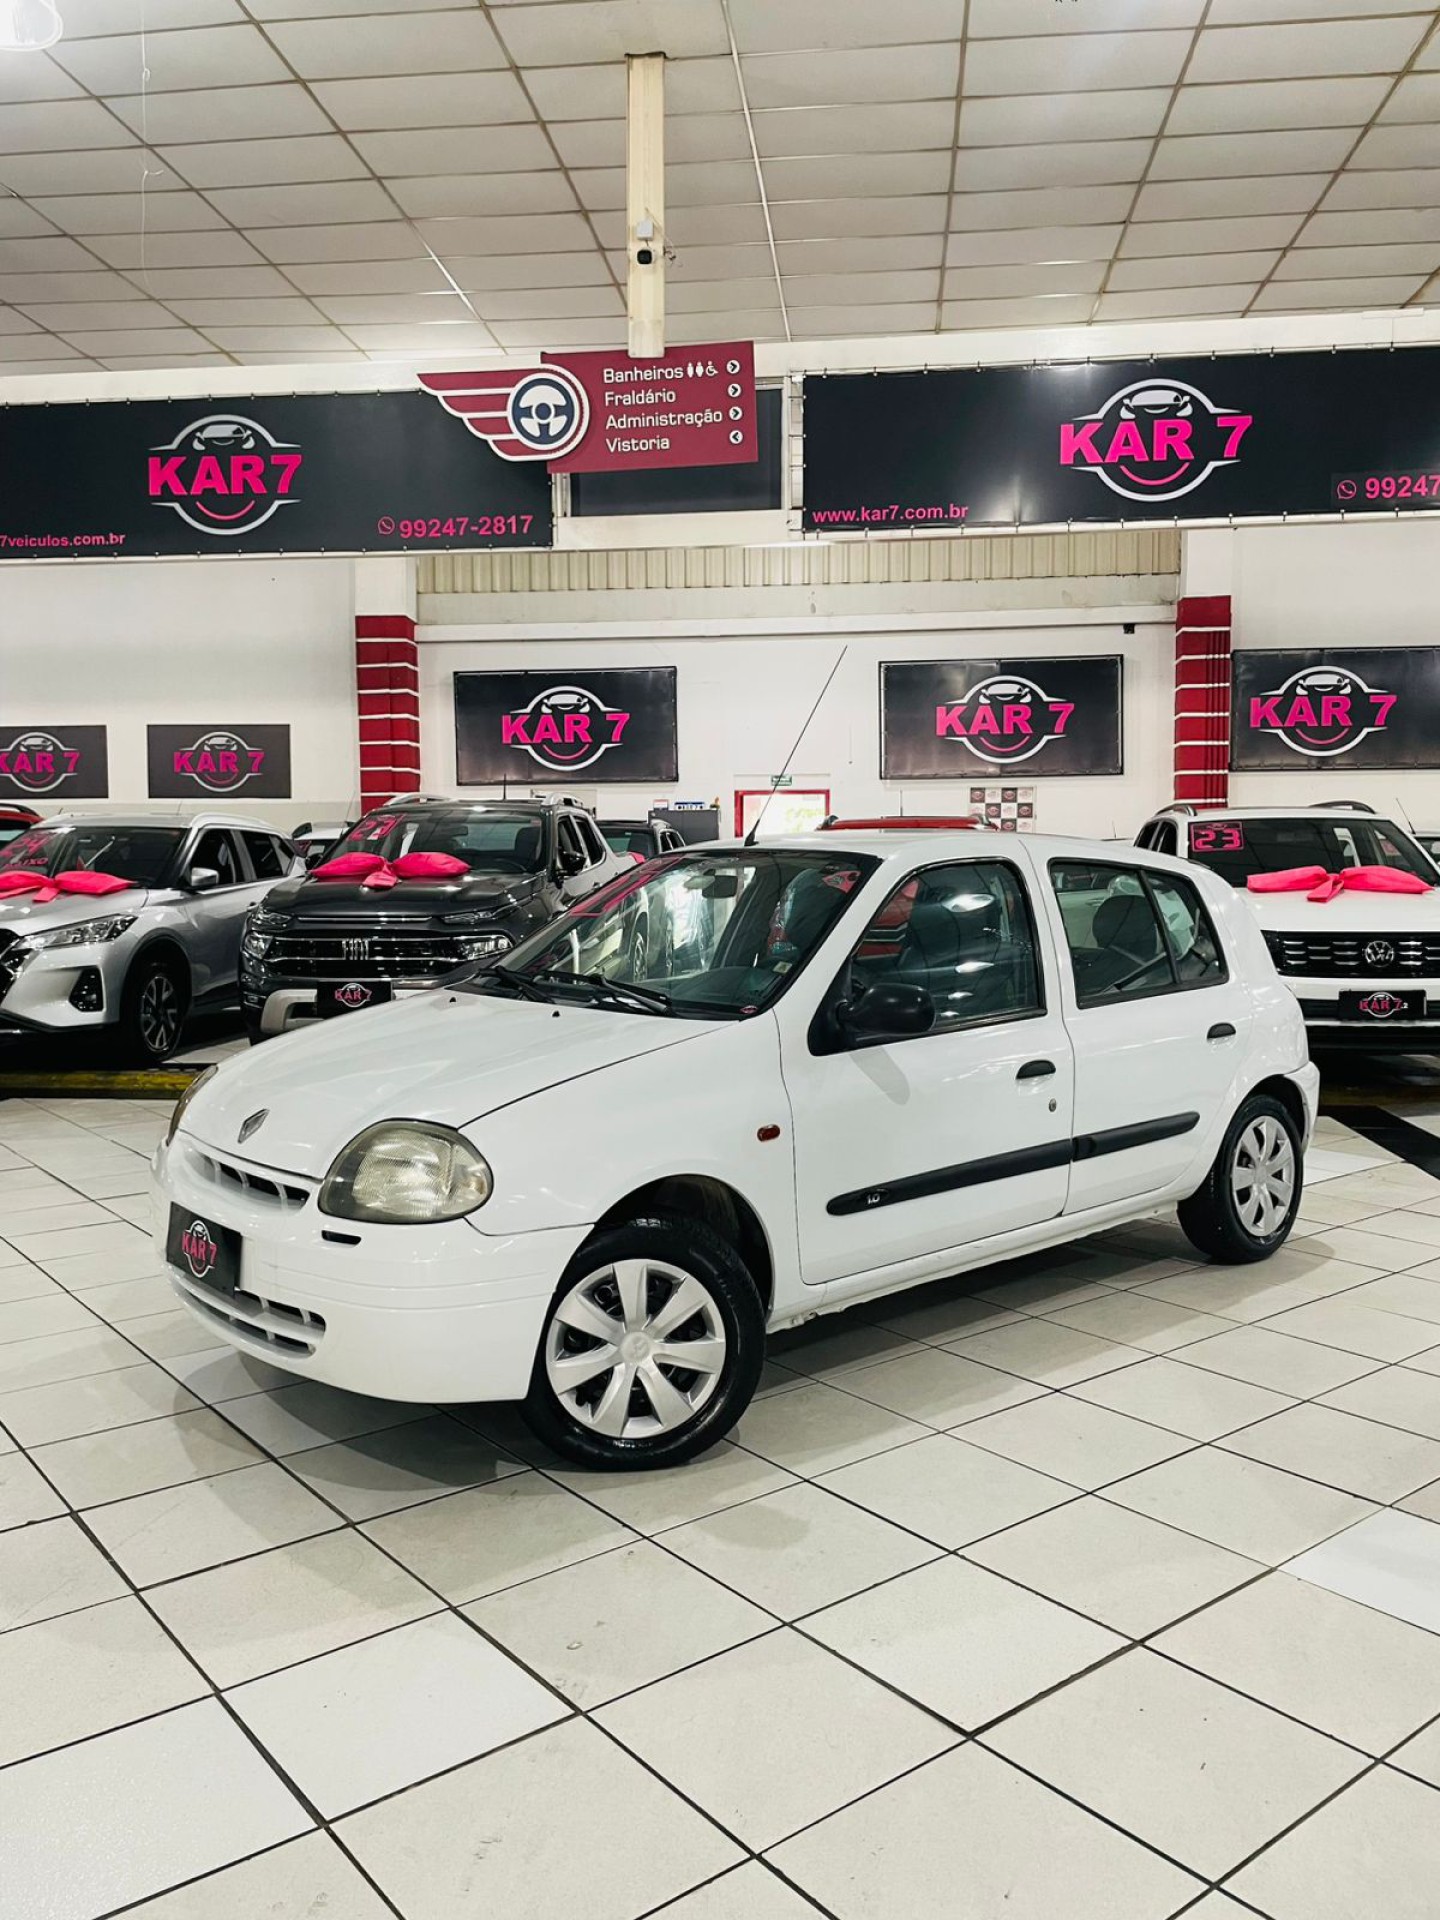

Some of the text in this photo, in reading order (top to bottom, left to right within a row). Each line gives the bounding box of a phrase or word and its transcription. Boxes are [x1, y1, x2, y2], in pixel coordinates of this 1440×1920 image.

[603, 365, 684, 384] Banheiros
[605, 388, 676, 407] Fraldário
[605, 409, 723, 430] Administração
[606, 435, 670, 453] Vistoria
[1060, 415, 1253, 466] KAR 7
[812, 504, 969, 523] www.kar7.com.br
[399, 514, 533, 538] 99247-2817
[0, 533, 126, 548] 7veiculos.com.br
[936, 702, 1075, 736] KAR 7
[1250, 694, 1398, 728] KAR 7
[502, 712, 630, 745] KAR 7
[63, 750, 81, 773] 7
[173, 750, 265, 774] KAR 7
[1194, 828, 1241, 849] 23
[334, 988, 362, 1001] KAR
[1359, 998, 1390, 1011] KAR
[183, 1232, 218, 1265] KAR 7
